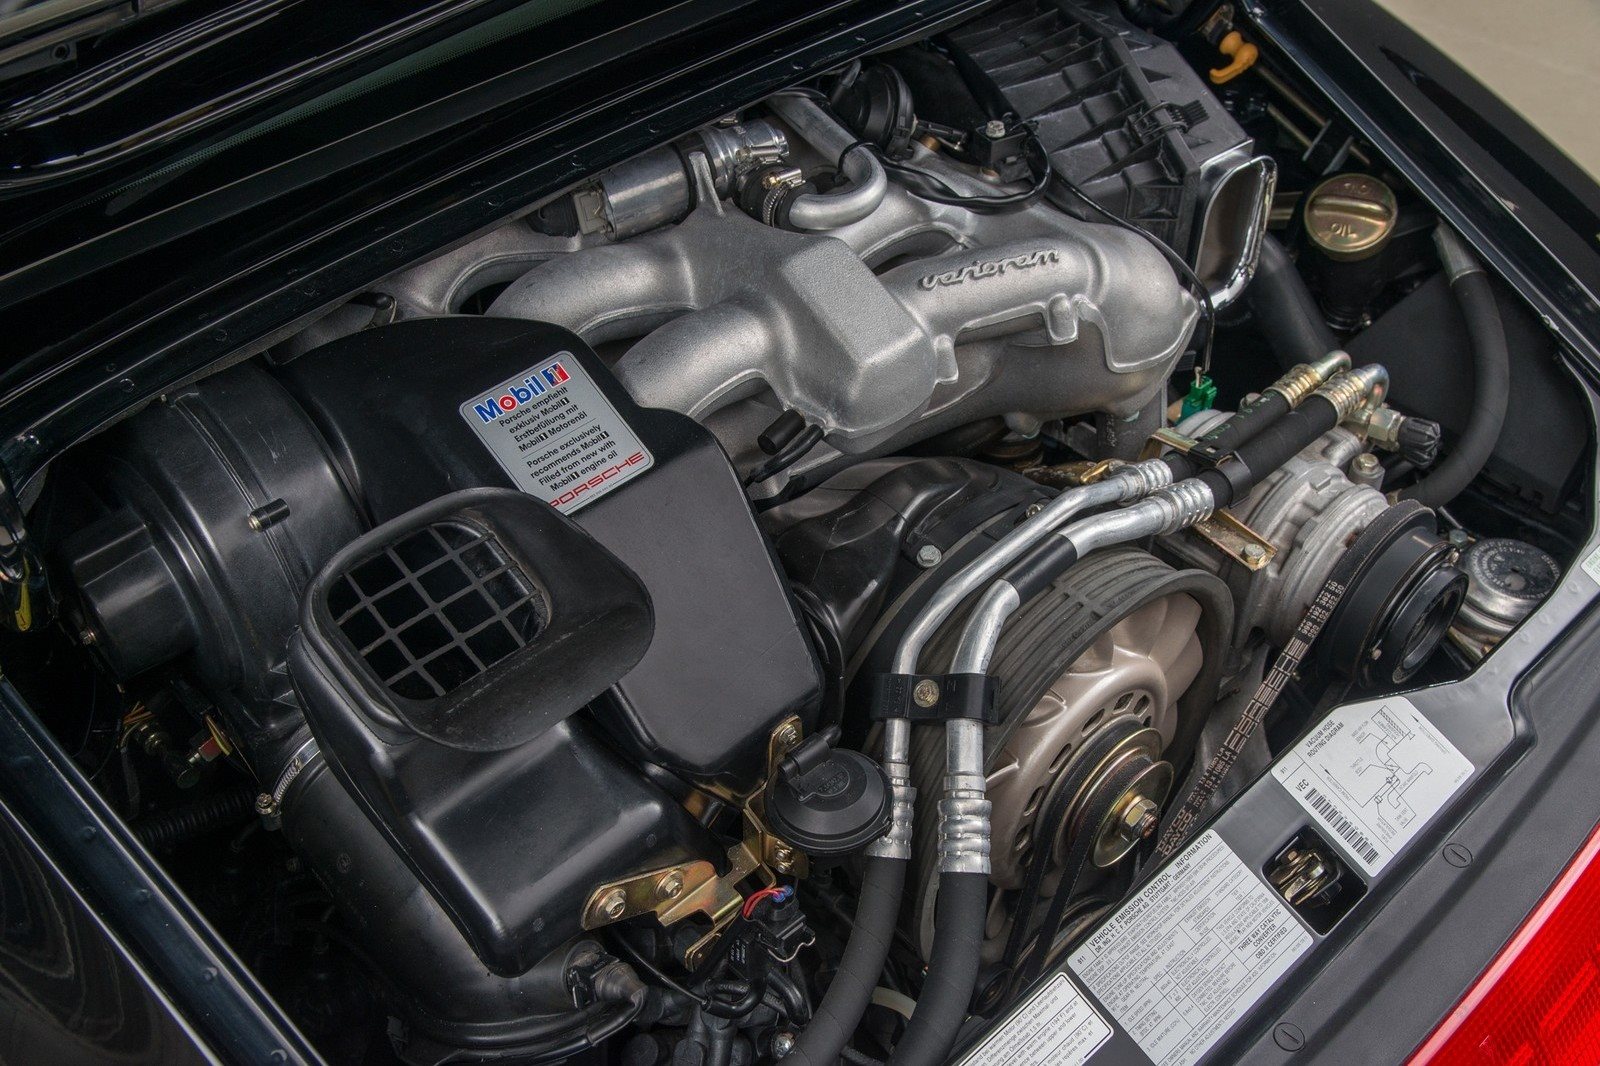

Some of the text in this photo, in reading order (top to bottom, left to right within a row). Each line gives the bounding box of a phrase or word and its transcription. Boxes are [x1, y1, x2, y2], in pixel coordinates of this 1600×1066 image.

[1330, 222, 1358, 238] OIL
[471, 361, 571, 424] Mobil 1
[498, 385, 569, 427] Porsche empfiehlt
[507, 412, 541, 434] exklusiv
[513, 403, 579, 443] Erstbefüllung mit
[547, 410, 587, 436] Motorenöl
[526, 423, 602, 468] Porsche exclusively
[529, 446, 581, 478] recommends
[538, 439, 615, 485] Filled from new with
[579, 456, 608, 476] engine
[605, 449, 618, 459] oil
[1316, 609, 1328, 624] 192
[1335, 584, 1344, 594] 50
[1203, 779, 1213, 788] 13
[1212, 759, 1226, 775] 1085
[1221, 749, 1232, 761] LA
[1300, 620, 1313, 635] 999
[1309, 605, 1322, 620] 192
[1328, 580, 1337, 591] 50
[1304, 729, 1325, 748] VACUUM
[1321, 718, 1335, 732] HOSE
[1306, 738, 1327, 758] ROUTING
[1323, 720, 1345, 741] DIAGRAM
[1294, 777, 1310, 793] VEC
[1088, 921, 1116, 948] VEHICLE
[1114, 895, 1144, 924] EMISSION
[1142, 870, 1171, 898] CONTROL
[1174, 832, 1212, 869] INFORMATION
[1123, 907, 1143, 926] PORSCHE
[1148, 880, 1172, 903] STUTTGART
[1171, 862, 1192, 881] GERMANY
[1237, 908, 1281, 952] THREE WAY CATALYTIC
[1252, 922, 1277, 947] CONVERTER
[1254, 947, 1265, 959] OBD
[1266, 925, 1288, 947] CERTIFIED
[1003, 1023, 1016, 1036] Motor
